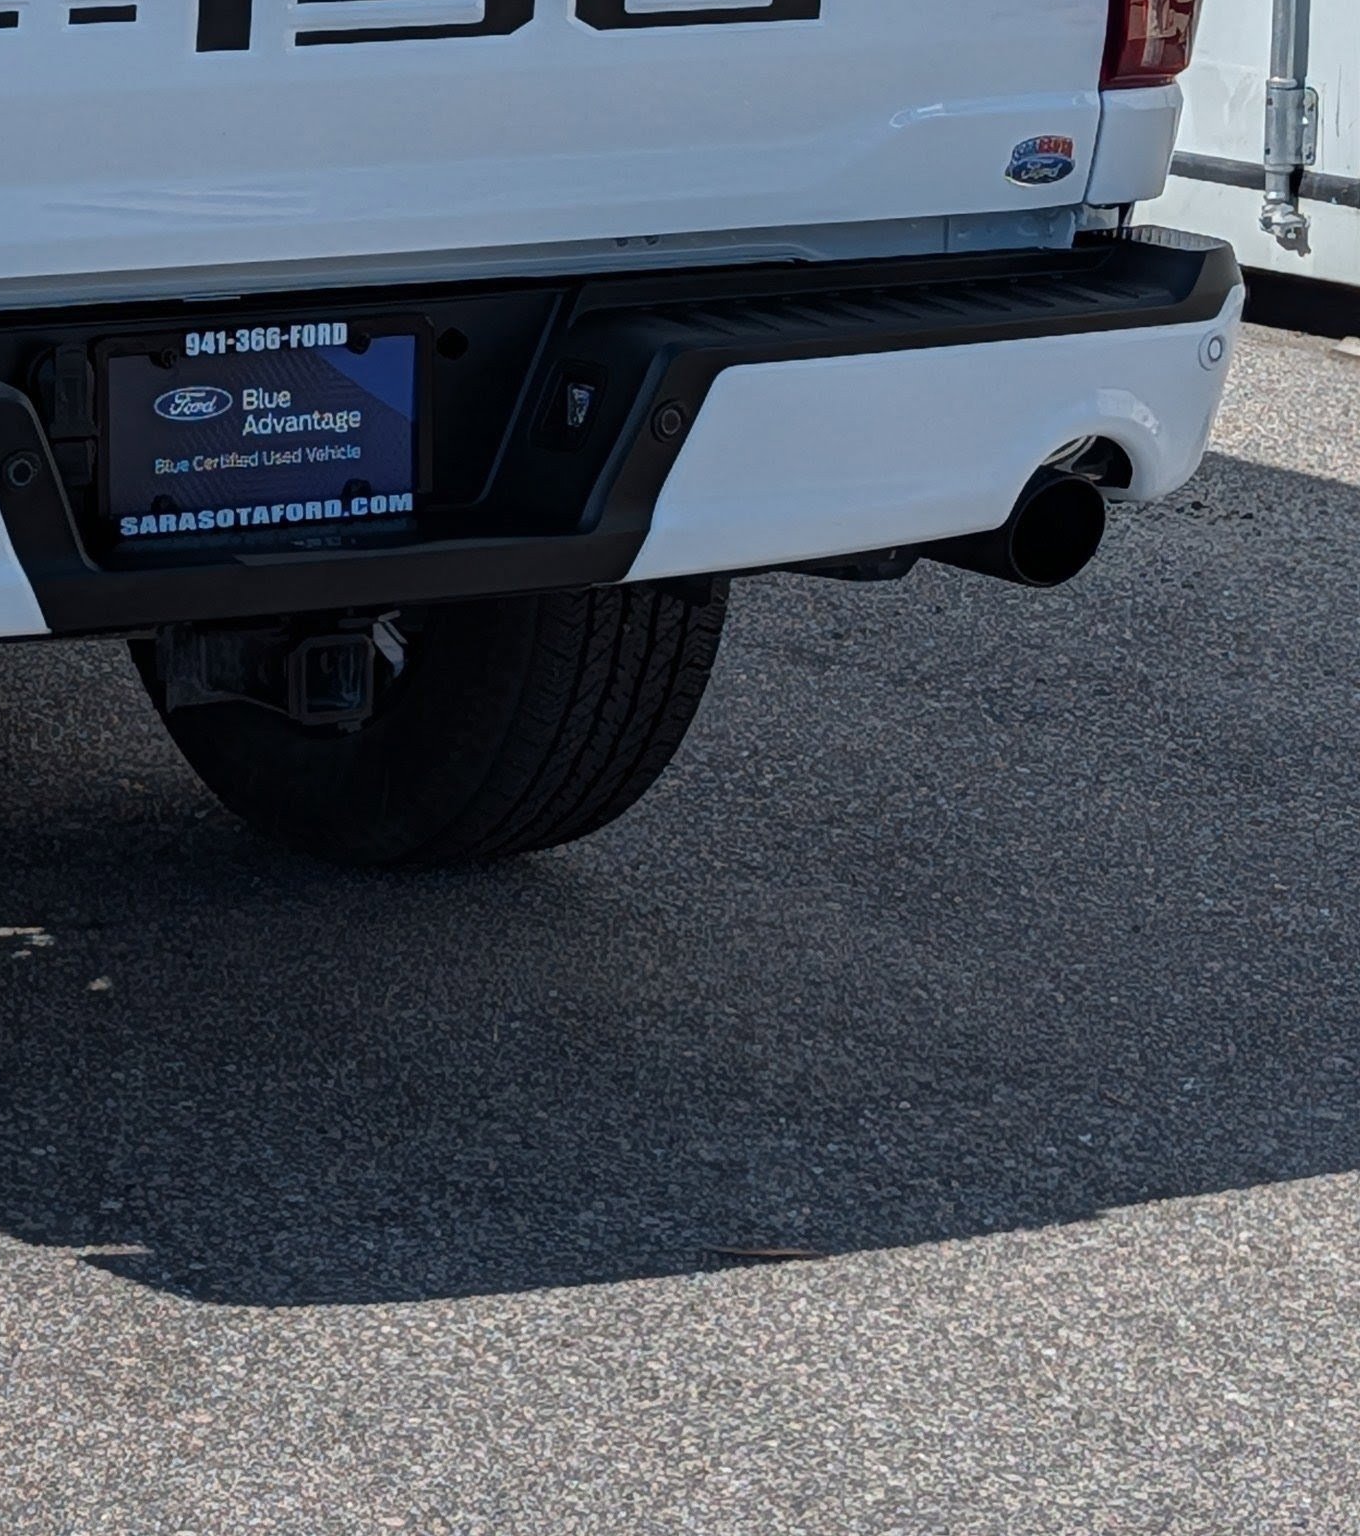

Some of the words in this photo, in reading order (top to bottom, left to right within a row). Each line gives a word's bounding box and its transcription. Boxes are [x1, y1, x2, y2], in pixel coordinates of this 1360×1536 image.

[185, 322, 348, 357] 941-366-FORD
[169, 391, 217, 415] Ford
[242, 388, 291, 410] Blue
[242, 410, 361, 436] Advantage
[262, 447, 302, 465] Used
[305, 444, 361, 463] Vehicle
[120, 493, 413, 536] SARASOTAFORD.COM
